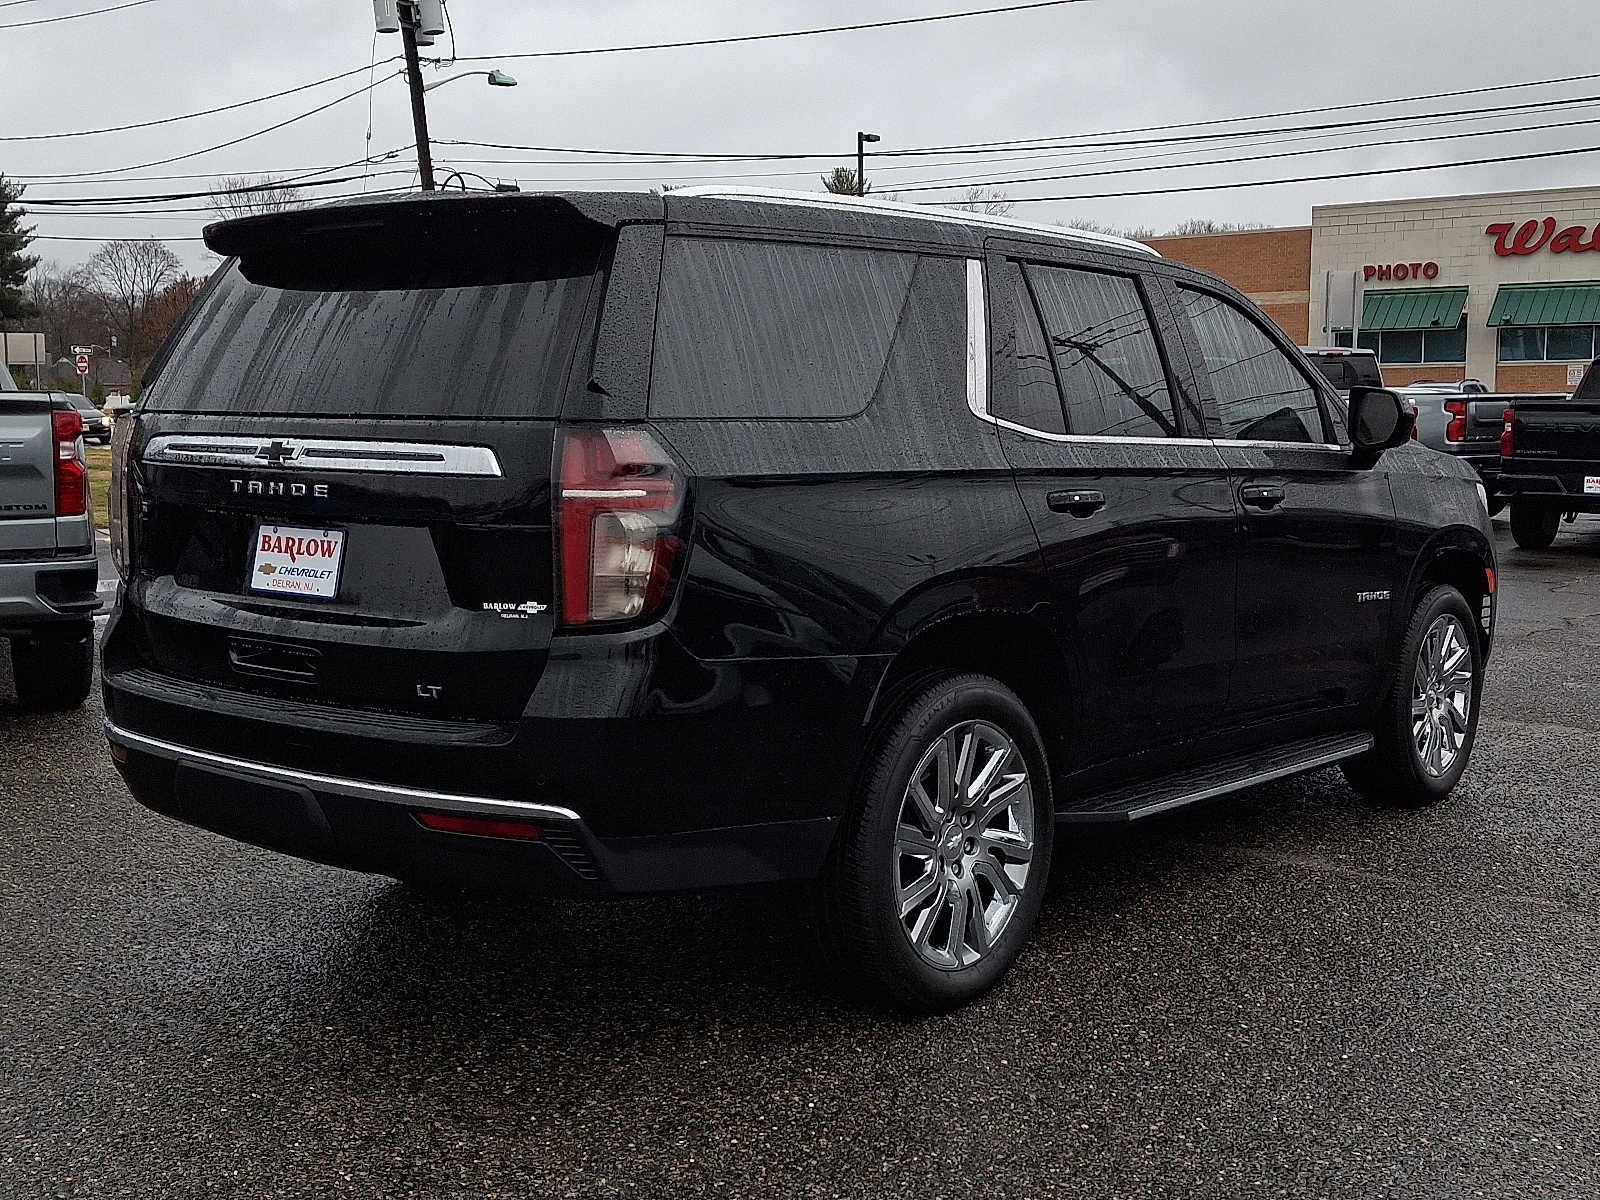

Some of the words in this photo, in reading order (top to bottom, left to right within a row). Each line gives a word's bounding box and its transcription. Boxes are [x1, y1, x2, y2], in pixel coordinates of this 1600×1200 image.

[1363, 261, 1439, 281] PHOTO
[230, 479, 329, 497] TAHOE
[260, 534, 338, 564] BARLOW
[278, 565, 334, 579] CHEVROLET
[272, 578, 302, 591] DELRAN,
[303, 582, 314, 591] NJ
[1356, 590, 1391, 602] TAHOE
[483, 602, 516, 612] BARLOW
[416, 684, 442, 700] LT
